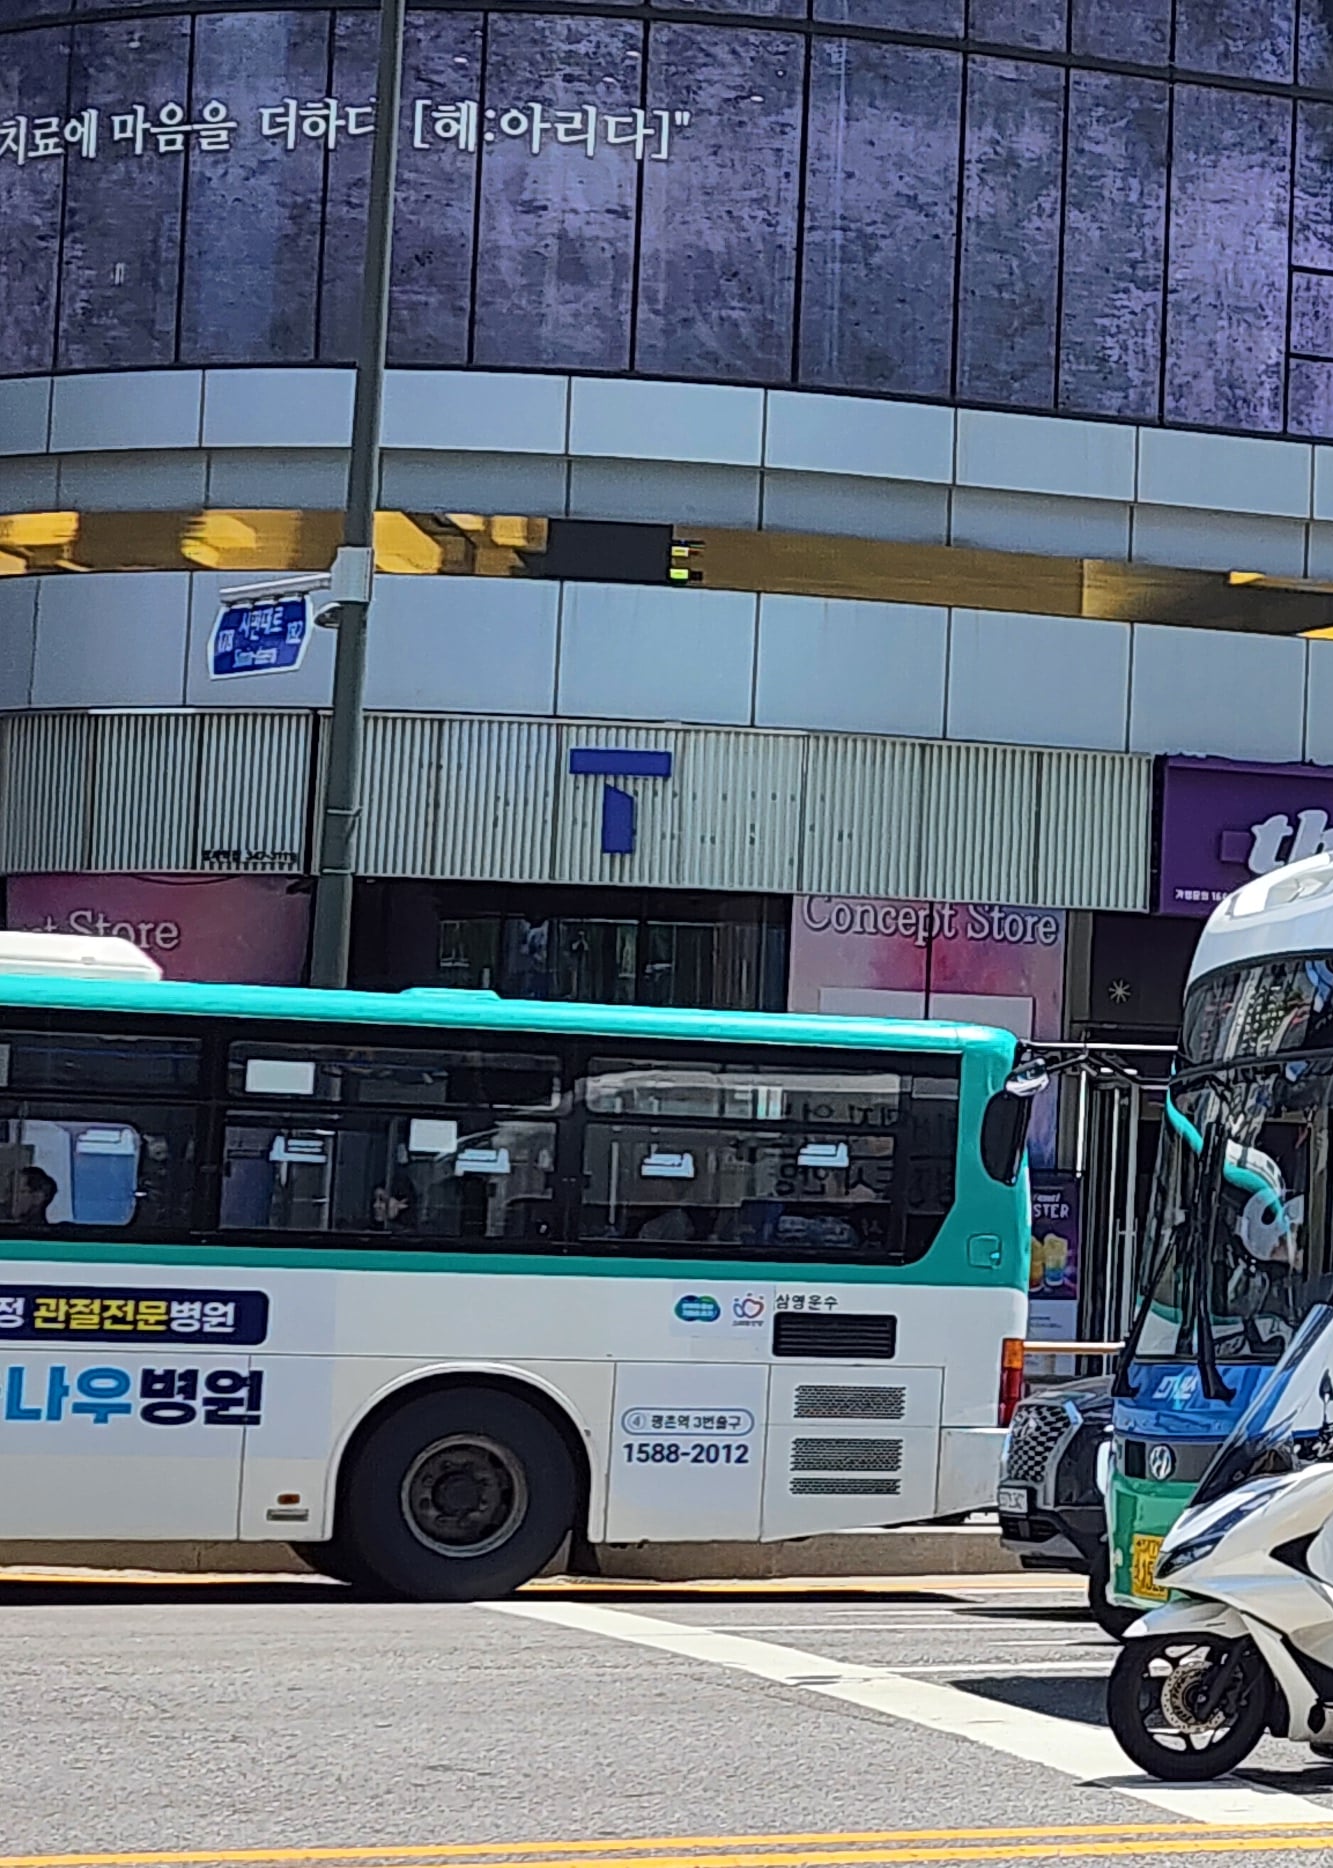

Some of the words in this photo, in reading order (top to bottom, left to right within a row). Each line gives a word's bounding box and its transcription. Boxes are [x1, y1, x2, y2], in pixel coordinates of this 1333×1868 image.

[0, 108, 98, 165] 치료에
[110, 100, 238, 156] 마음을
[802, 895, 956, 946] Concept
[966, 904, 1060, 945] Store
[33, 1297, 236, 1333] 관절전문병원
[776, 1293, 839, 1311] 삼영운수
[5, 1366, 264, 1426] 나우병원
[693, 1415, 741, 1430] 3번출구
[623, 1443, 749, 1463] 1588-2012
